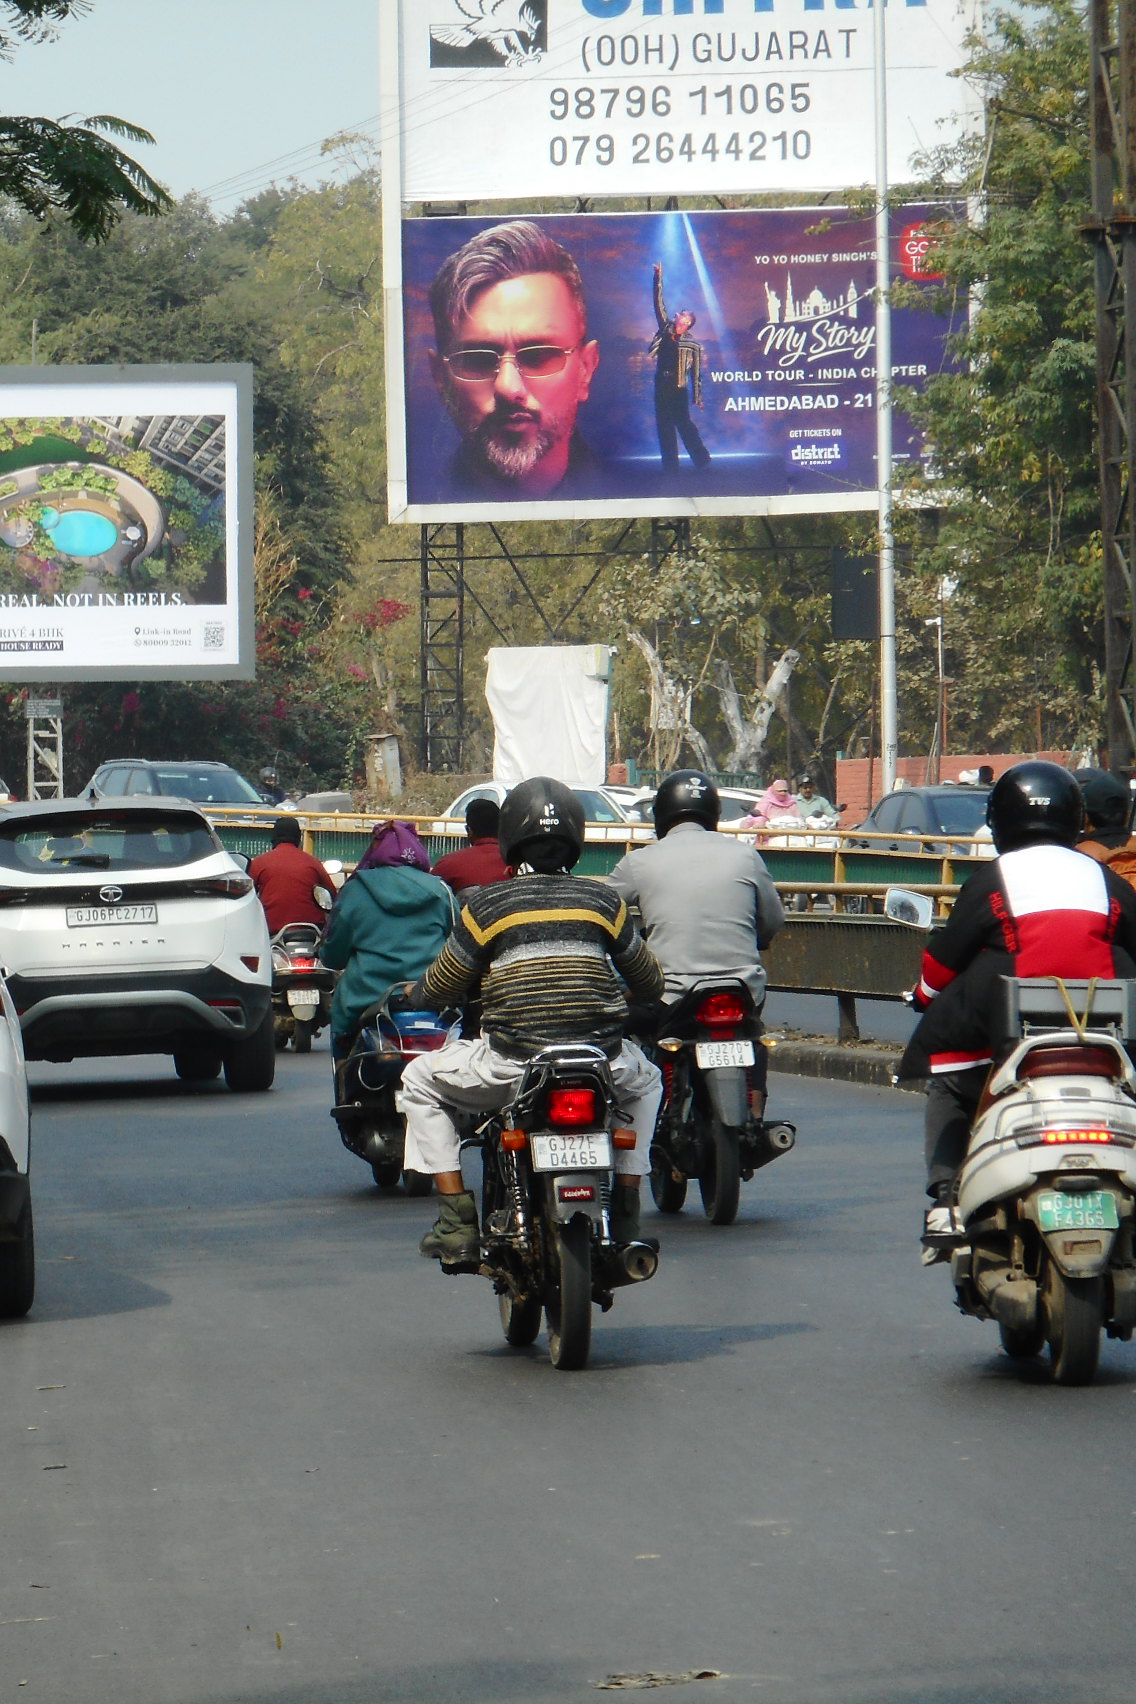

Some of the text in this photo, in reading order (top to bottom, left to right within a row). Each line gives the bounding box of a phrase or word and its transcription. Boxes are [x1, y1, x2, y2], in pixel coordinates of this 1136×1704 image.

[692, 28, 858, 64] GUJARAT
[549, 82, 813, 120] 98796 11065
[549, 130, 813, 167] 079 26444210
[755, 255, 770, 264] YO
[773, 255, 788, 264] YO
[790, 253, 829, 263] HONEY
[757, 320, 876, 366] My Story
[711, 370, 762, 383] WORLD
[766, 369, 805, 382] TOUR
[818, 367, 857, 380] INDIA
[860, 365, 927, 379] CHPTER
[724, 395, 840, 412] AHMEDABAD
[790, 429, 842, 438] GET TICKETS ON
[791, 443, 841, 460] district
[53, 593, 93, 608] NOT
[98, 593, 117, 607] IN
[123, 592, 188, 607] REELS.
[39, 628, 64, 638] BHK
[1, 641, 31, 650] HOUSE
[32, 641, 62, 650] READY
[1029, 797, 1051, 806] TVS
[76, 906, 154, 921] GJ06PC2717
[548, 1135, 595, 1152] GJ27F
[550, 1151, 597, 1167] D4465
